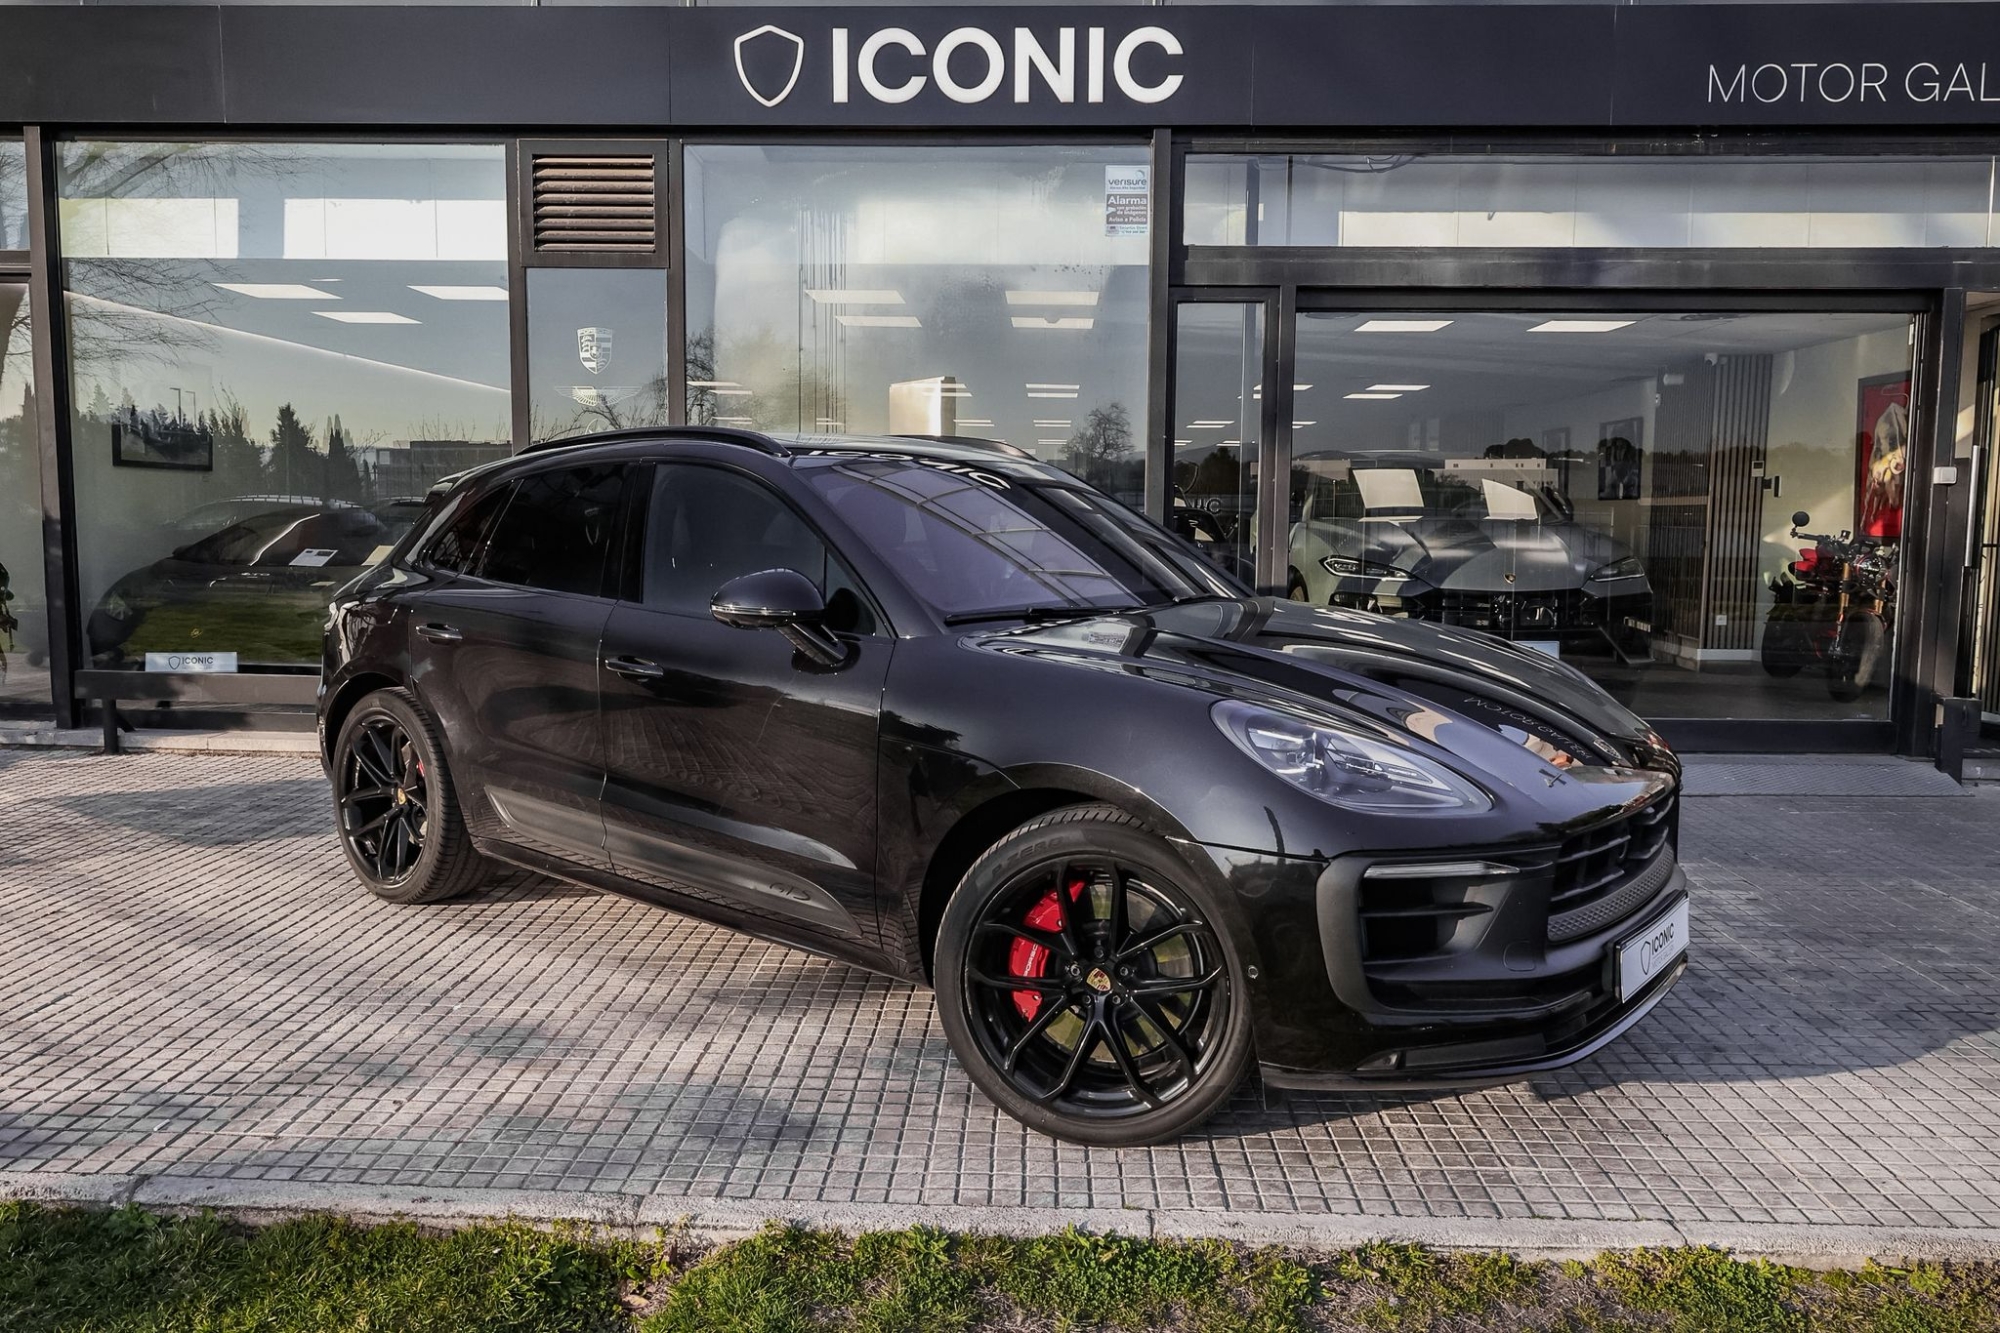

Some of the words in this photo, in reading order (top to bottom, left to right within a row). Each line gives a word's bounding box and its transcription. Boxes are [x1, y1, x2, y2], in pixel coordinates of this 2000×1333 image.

[832, 26, 1184, 104] ICONIC
[1708, 63, 1888, 103] MOTOR
[1905, 62, 2000, 102] GAL
[1108, 178, 1147, 186] verisure
[1108, 195, 1147, 205] Alarma
[182, 656, 214, 665] ICONIC
[1651, 922, 1675, 956] ICONIC
